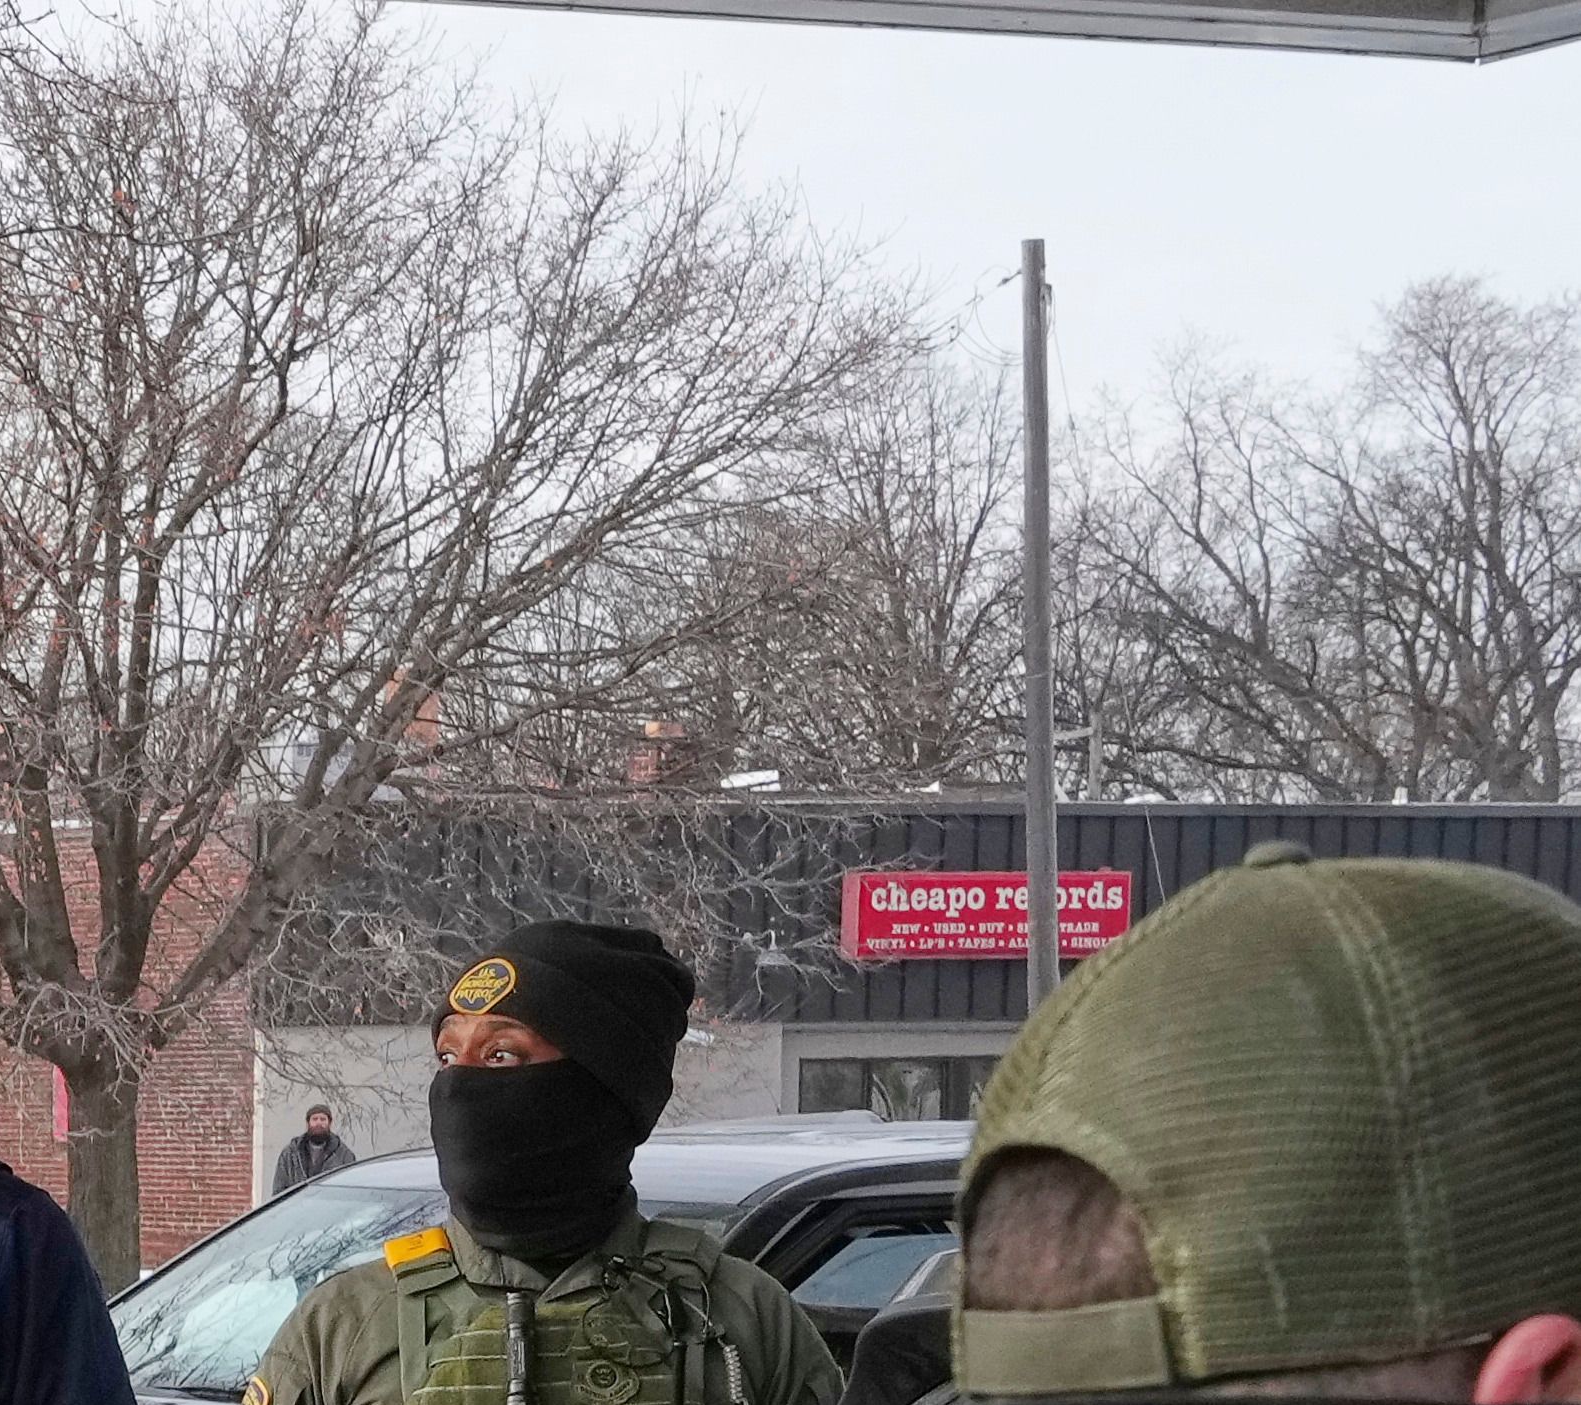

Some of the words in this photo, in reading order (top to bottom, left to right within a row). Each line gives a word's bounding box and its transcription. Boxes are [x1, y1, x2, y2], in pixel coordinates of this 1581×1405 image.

[871, 880, 986, 918] cheapo
[995, 881, 1123, 910] reords
[978, 922, 1005, 934] BUY
